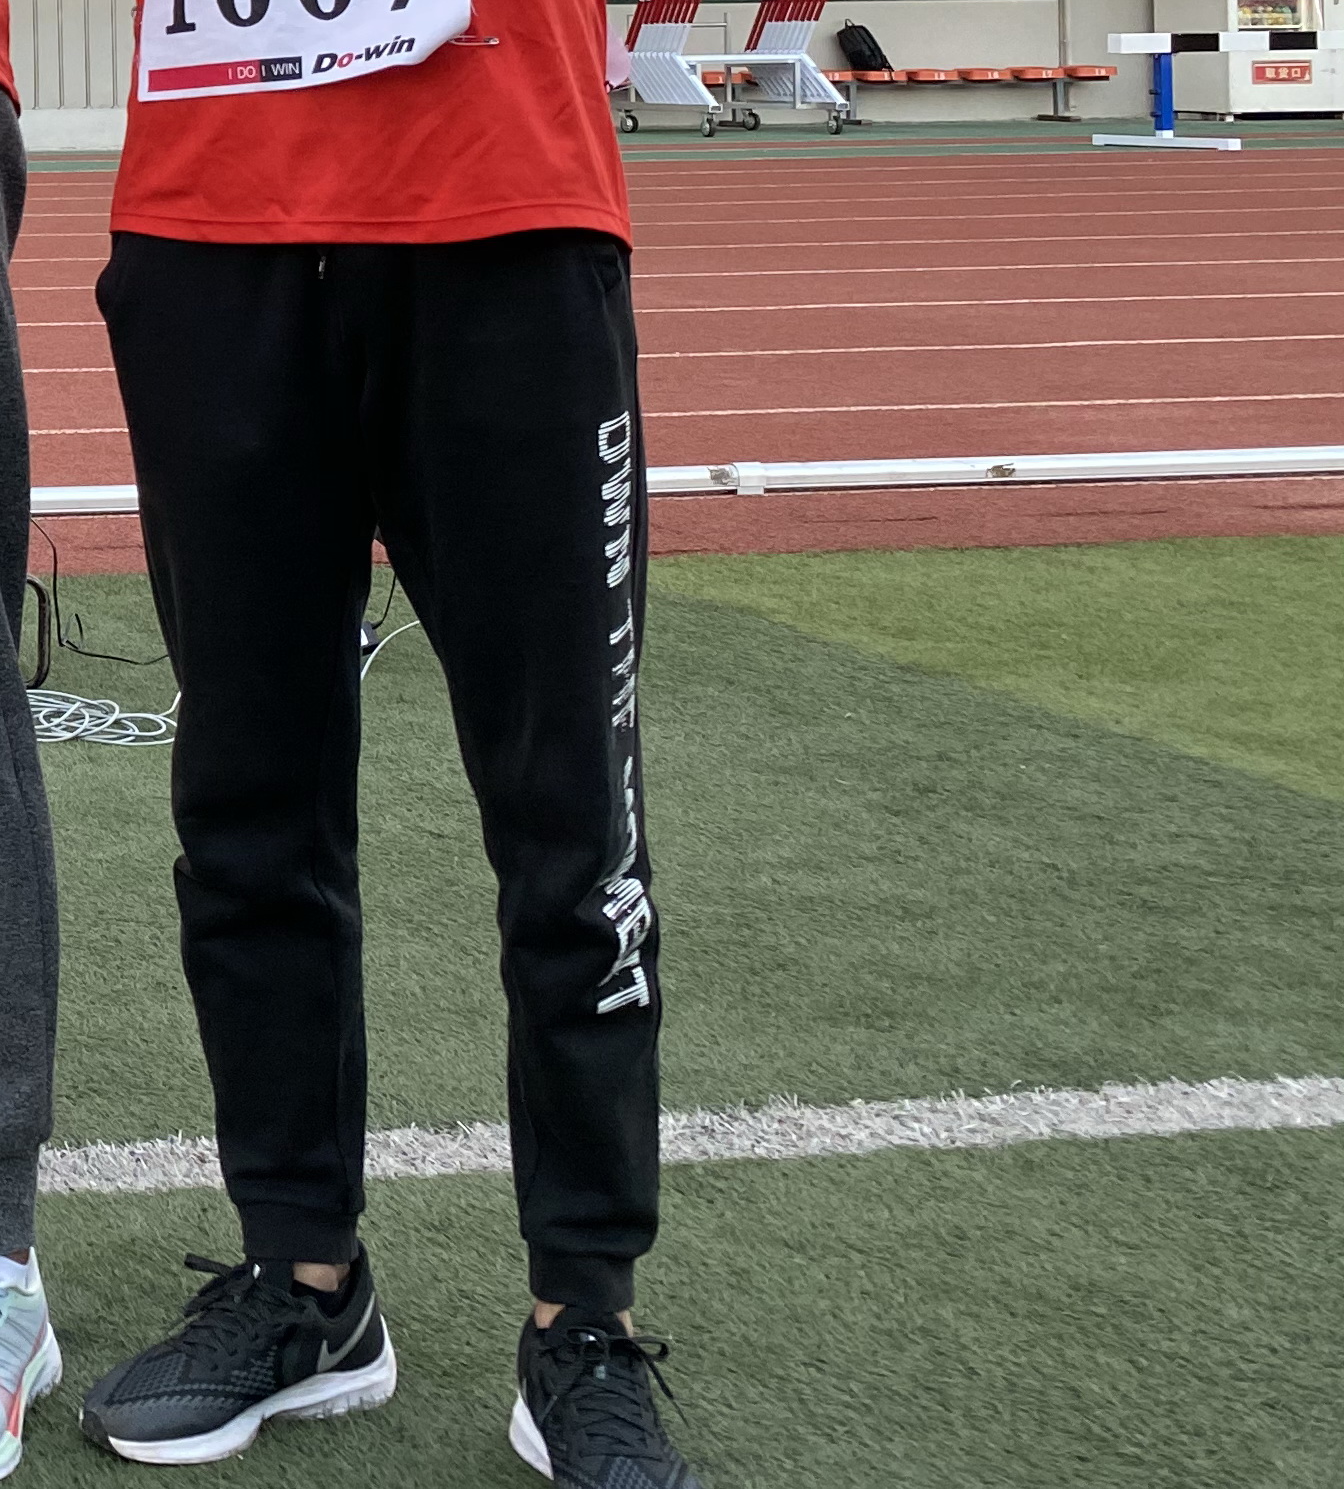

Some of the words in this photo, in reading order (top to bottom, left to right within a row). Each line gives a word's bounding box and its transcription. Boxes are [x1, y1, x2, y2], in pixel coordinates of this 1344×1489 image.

[237, 65, 256, 79] DO
[272, 62, 300, 77] WIN
[312, 34, 415, 74] Do-win
[597, 411, 633, 588] OWN
